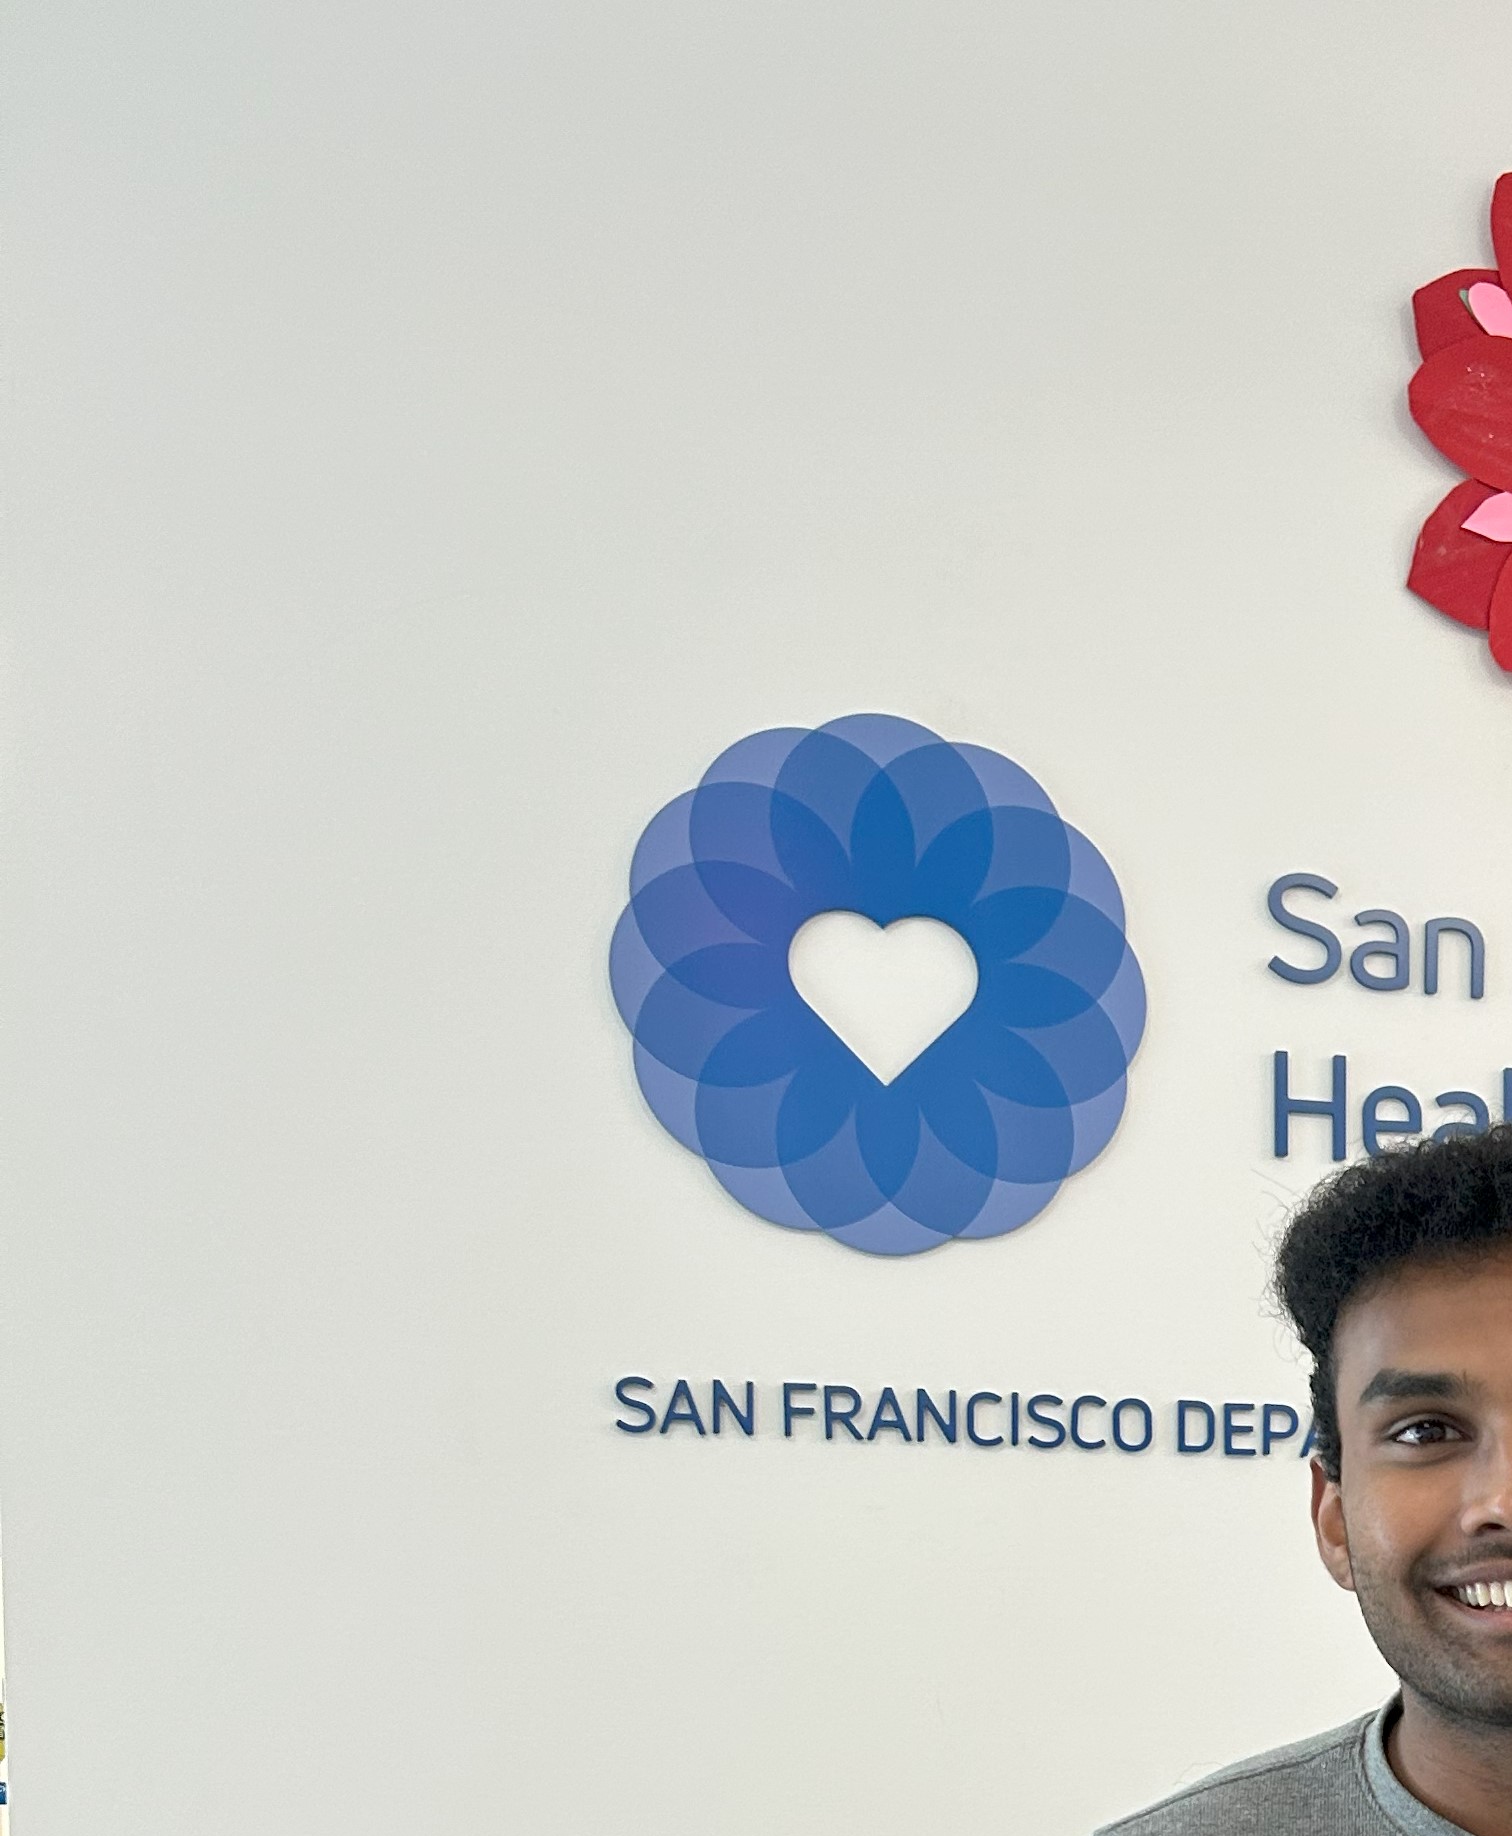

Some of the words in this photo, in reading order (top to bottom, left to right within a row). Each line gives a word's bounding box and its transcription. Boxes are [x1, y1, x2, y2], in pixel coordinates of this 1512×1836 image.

[1266, 872, 1486, 999] San
[614, 1376, 755, 1439] SAN
[782, 1382, 1154, 1454] FRANCISCO
